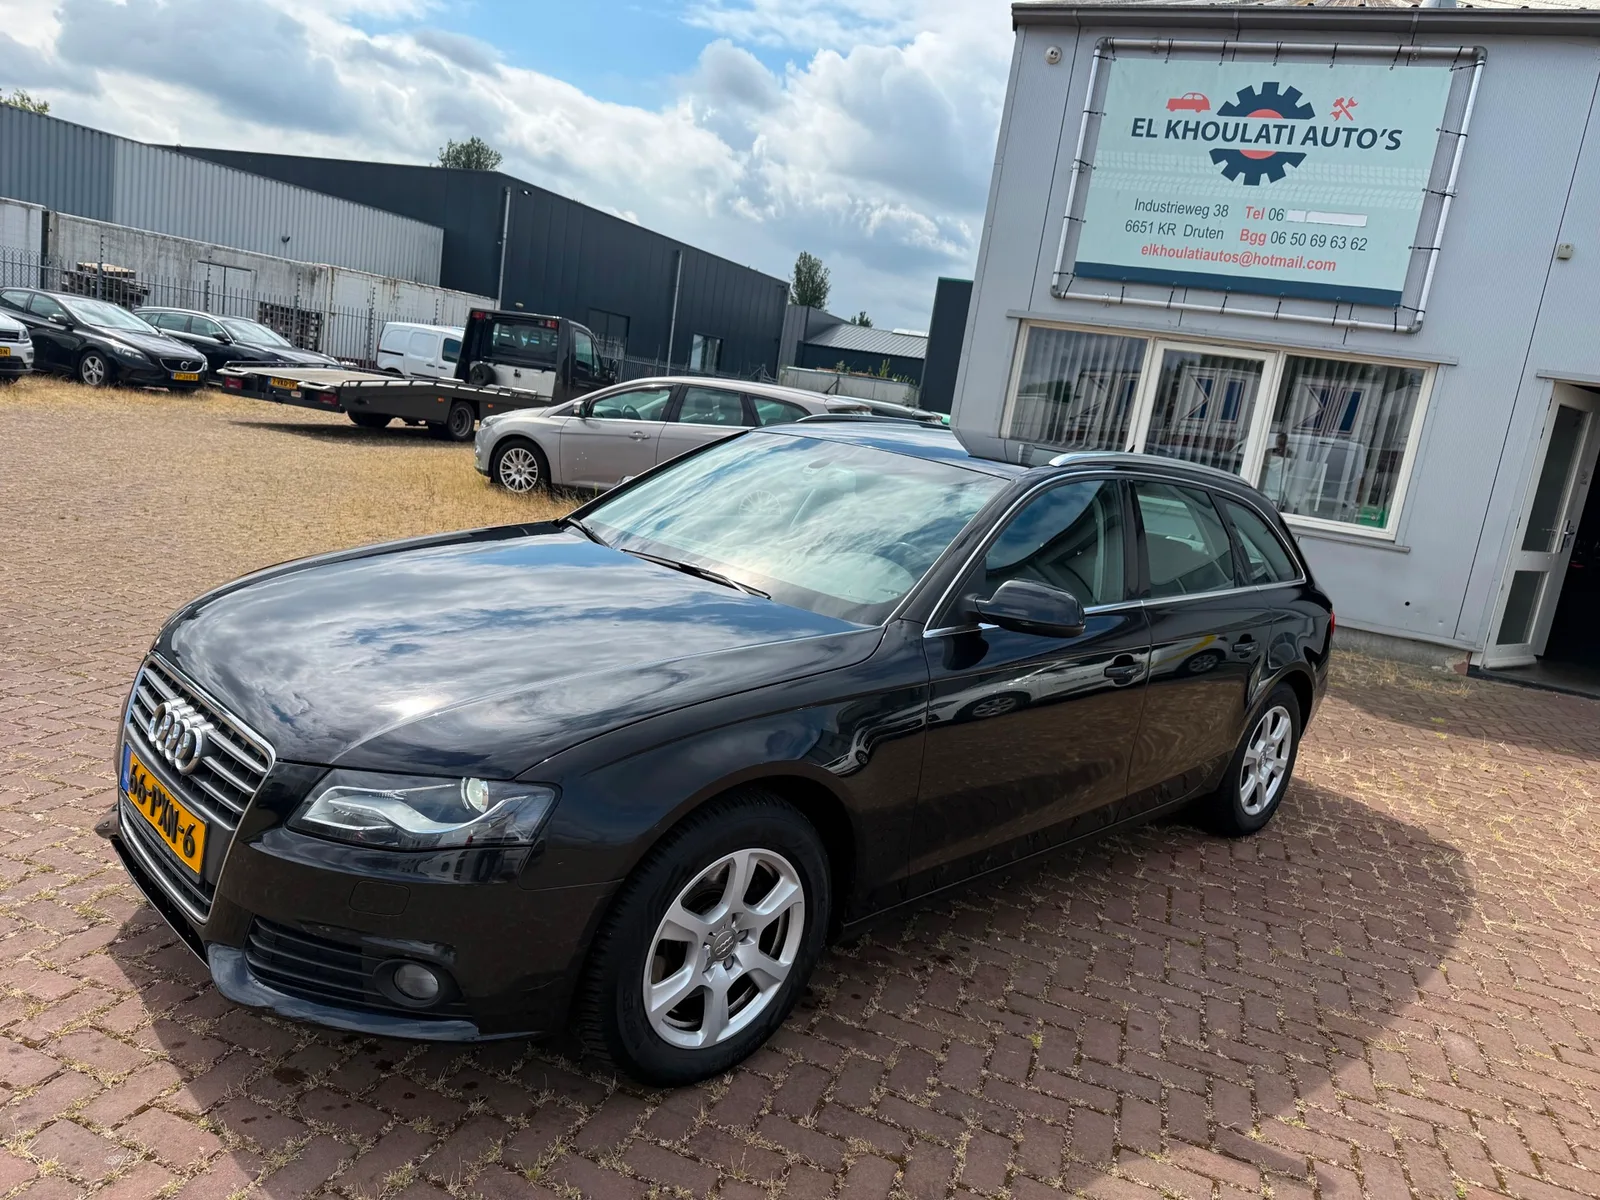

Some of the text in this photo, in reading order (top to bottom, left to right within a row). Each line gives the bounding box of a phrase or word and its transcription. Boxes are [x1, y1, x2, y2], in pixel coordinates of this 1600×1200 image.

[1131, 117, 1403, 151] EL KHOULATI AUTO'S
[1134, 198, 1229, 220] Industrieweg 38
[1245, 206, 1285, 221] Tel 06
[1125, 219, 1224, 240] 6651 KR Druten
[1240, 228, 1368, 251] Bgg 06 50 69 63 62
[1141, 243, 1336, 271] elkhoulatiautos@hotmail.com
[129, 763, 196, 858] 66-PXN-6
